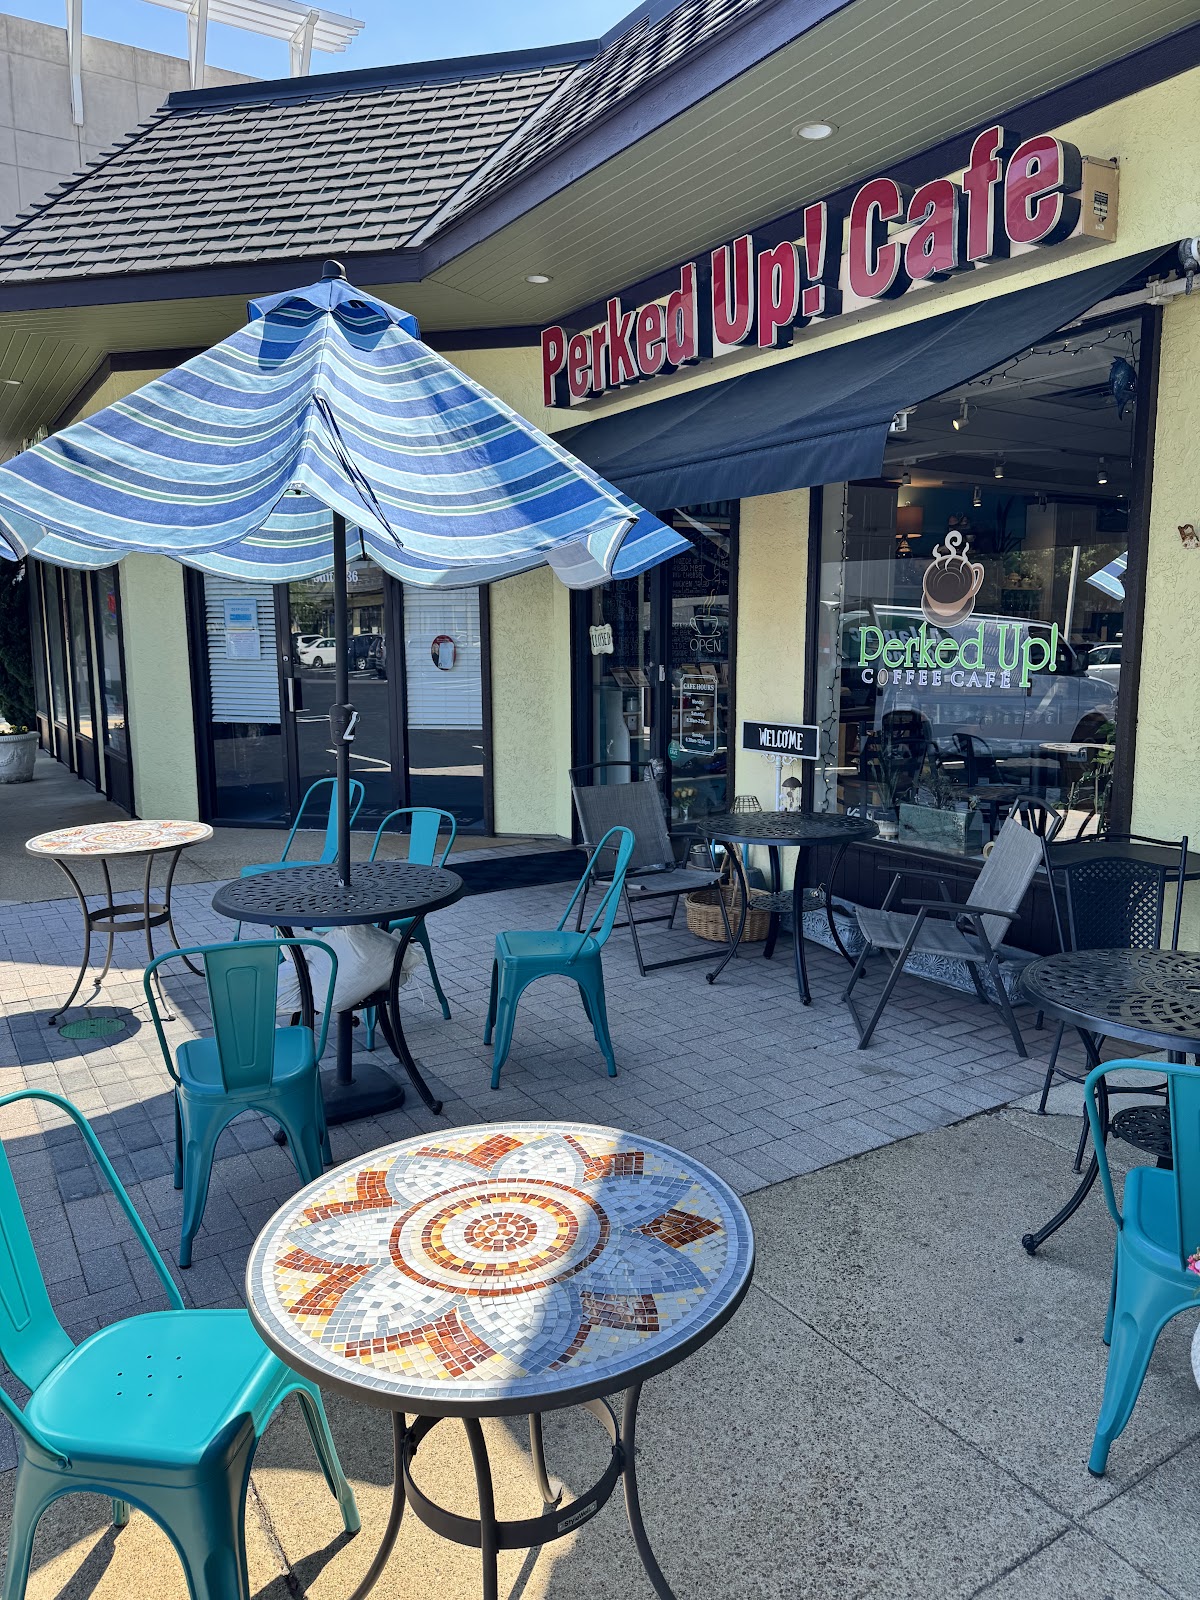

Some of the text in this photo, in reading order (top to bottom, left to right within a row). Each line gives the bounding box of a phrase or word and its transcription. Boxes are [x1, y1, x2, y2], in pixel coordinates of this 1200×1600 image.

[541, 125, 1064, 407] Perked Up! Cafe
[592, 632, 611, 647] CLOSED
[689, 638, 721, 653] OPEN
[858, 621, 1059, 688] Perked Up!
[861, 668, 1011, 689] COFFEE CAFÉ
[758, 727, 804, 751] WELCOME
